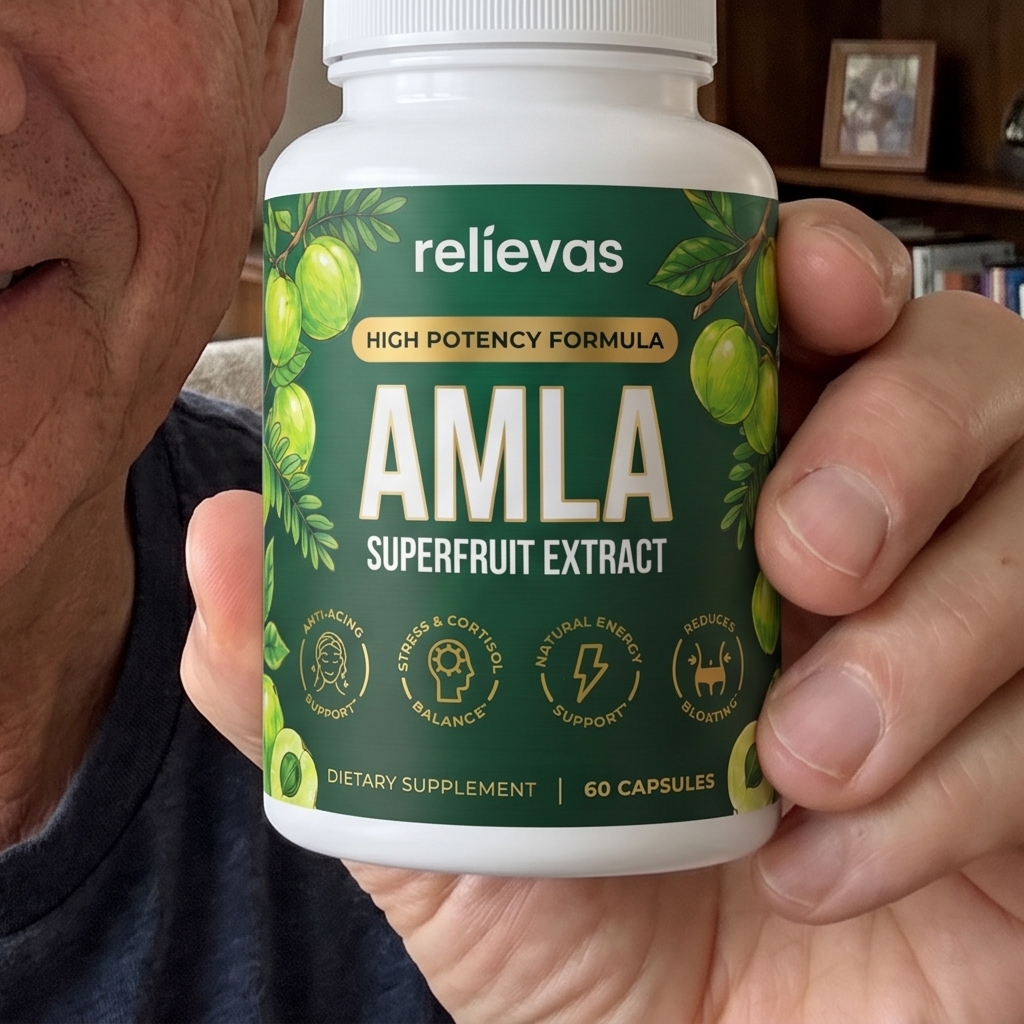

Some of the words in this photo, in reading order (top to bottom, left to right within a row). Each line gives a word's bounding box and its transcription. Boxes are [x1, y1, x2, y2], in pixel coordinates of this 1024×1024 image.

[367, 331, 419, 349] HIGH
[427, 331, 542, 349] POTENCY
[549, 331, 665, 350] FORMULA
[359, 384, 673, 522] AMLA
[367, 535, 535, 575] SUPERFRUIT
[543, 538, 668, 575] EXTRACT
[535, 616, 592, 667] NATURAL
[596, 616, 643, 663] ENERGY
[683, 613, 736, 635] REDUCES
[398, 620, 430, 672] STRESS
[433, 616, 443, 627] &
[447, 615, 503, 674] CORTISOL
[327, 768, 397, 790] DIETARY
[402, 776, 537, 797] SUPPLEMENT
[584, 780, 611, 798] 60
[618, 773, 715, 796] CAPSULES
